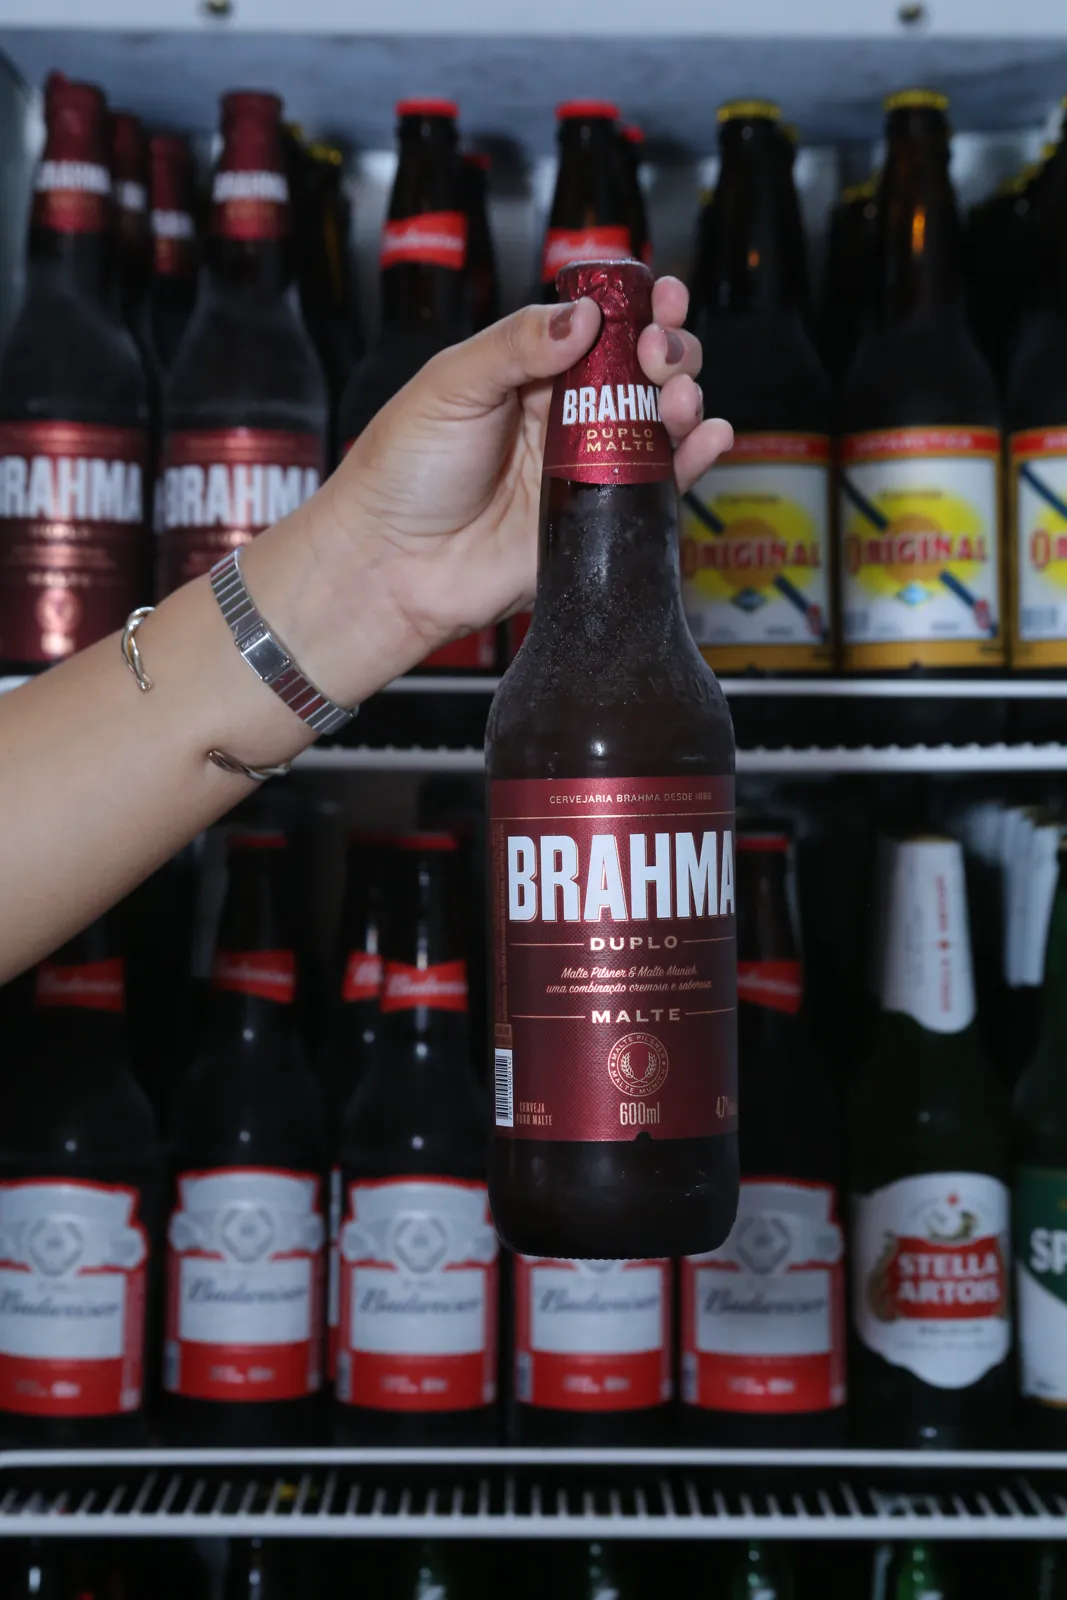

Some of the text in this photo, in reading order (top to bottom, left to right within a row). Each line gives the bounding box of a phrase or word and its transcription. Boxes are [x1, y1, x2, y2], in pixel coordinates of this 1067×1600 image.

[562, 383, 660, 426] BRAHM
[586, 427, 654, 440] DUPLO
[586, 441, 655, 453] MALTE
[549, 795, 613, 804] CERVEJARIA
[616, 794, 661, 803] BRAHMA
[664, 792, 693, 802] DESDE
[589, 935, 679, 951] DUPLO
[561, 967, 588, 979] Malte
[590, 966, 627, 979] Pilsner
[628, 966, 637, 978] &
[638, 965, 665, 977] Malte
[546, 984, 568, 994] uma
[569, 981, 627, 995] combinação
[629, 982, 668, 993] cremosa
[670, 982, 677, 992] e
[591, 1008, 681, 1024] MALTE
[611, 1034, 666, 1061] MALTE PILSNER
[611, 1069, 667, 1095] MALTE MUNICH
[519, 1101, 545, 1114] CERVEJA
[619, 1101, 660, 1126] 600ml
[532, 1114, 553, 1126] MALTE
[897, 1252, 999, 1279] STELLA
